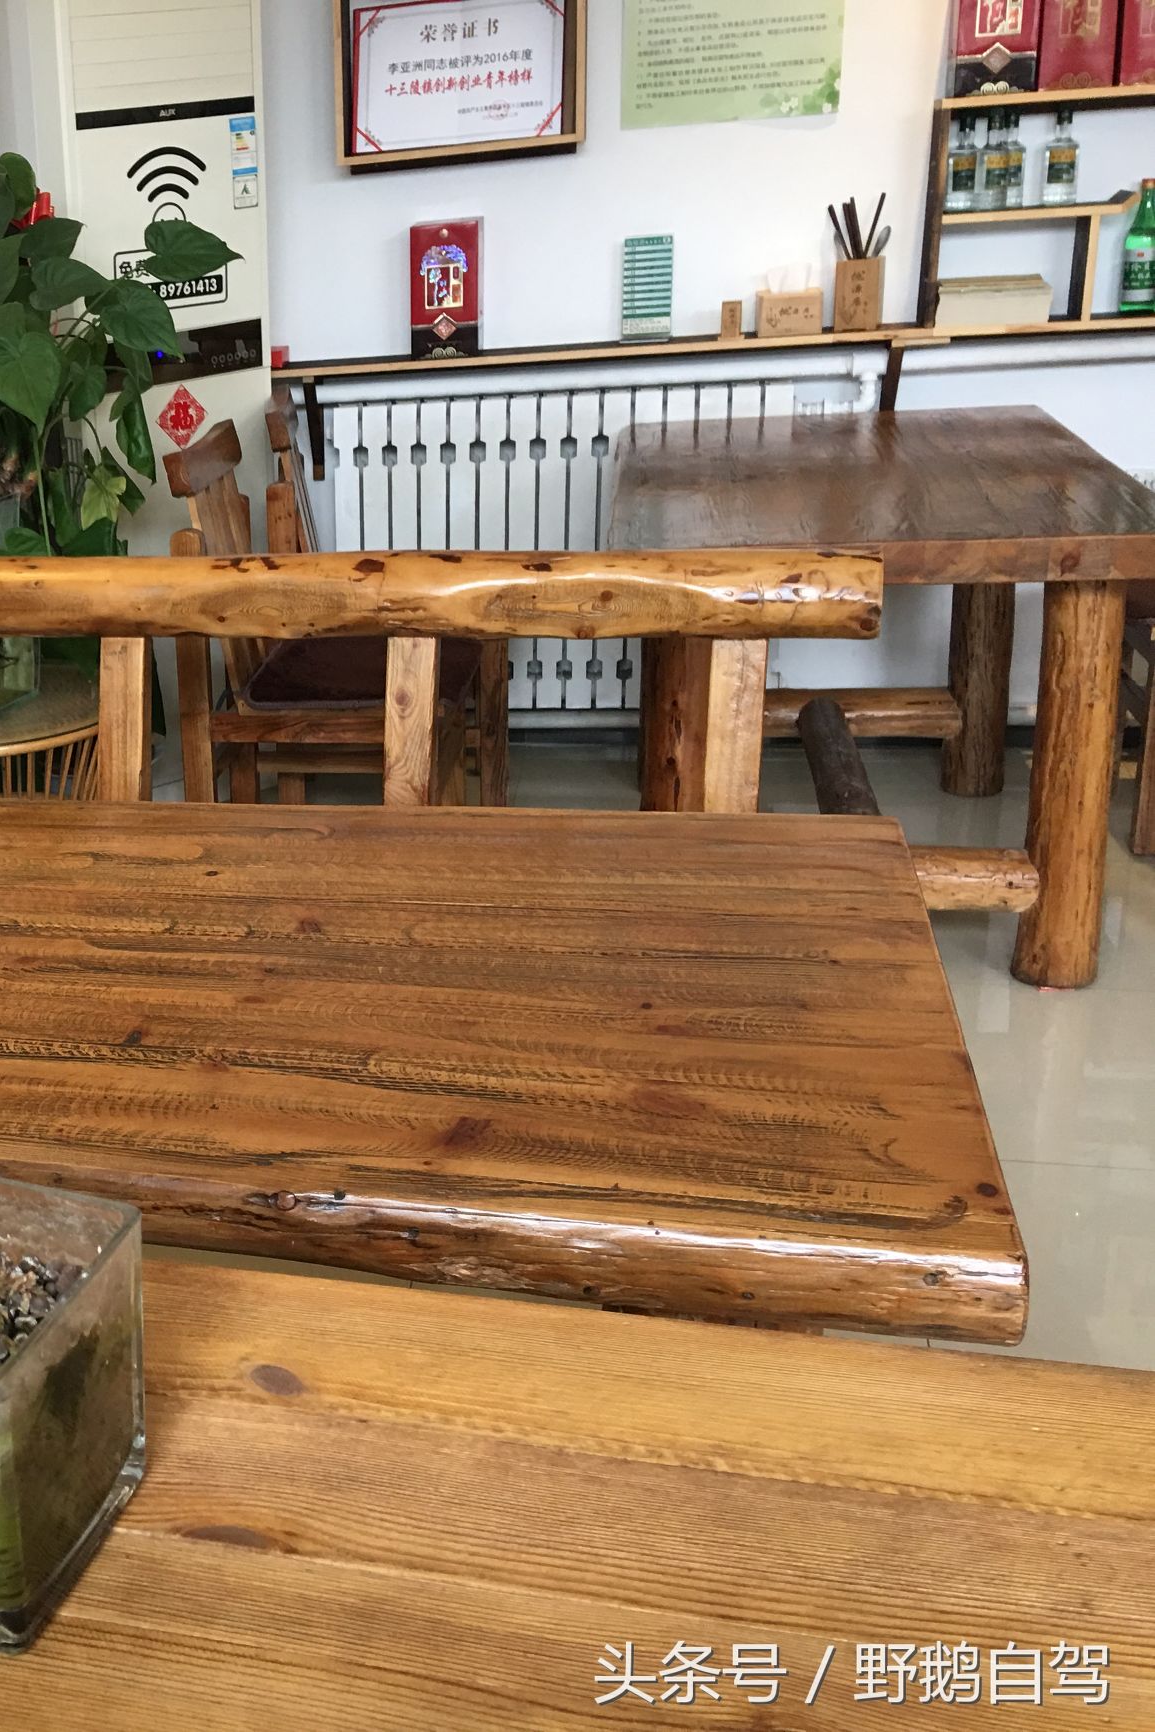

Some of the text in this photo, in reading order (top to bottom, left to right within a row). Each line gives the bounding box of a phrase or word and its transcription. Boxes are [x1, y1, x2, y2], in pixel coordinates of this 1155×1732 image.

[420, 18, 499, 43] 荣誉证书
[385, 68, 533, 96] 十三陵镇创新创业青年榜样
[159, 278, 218, 298] 89761413
